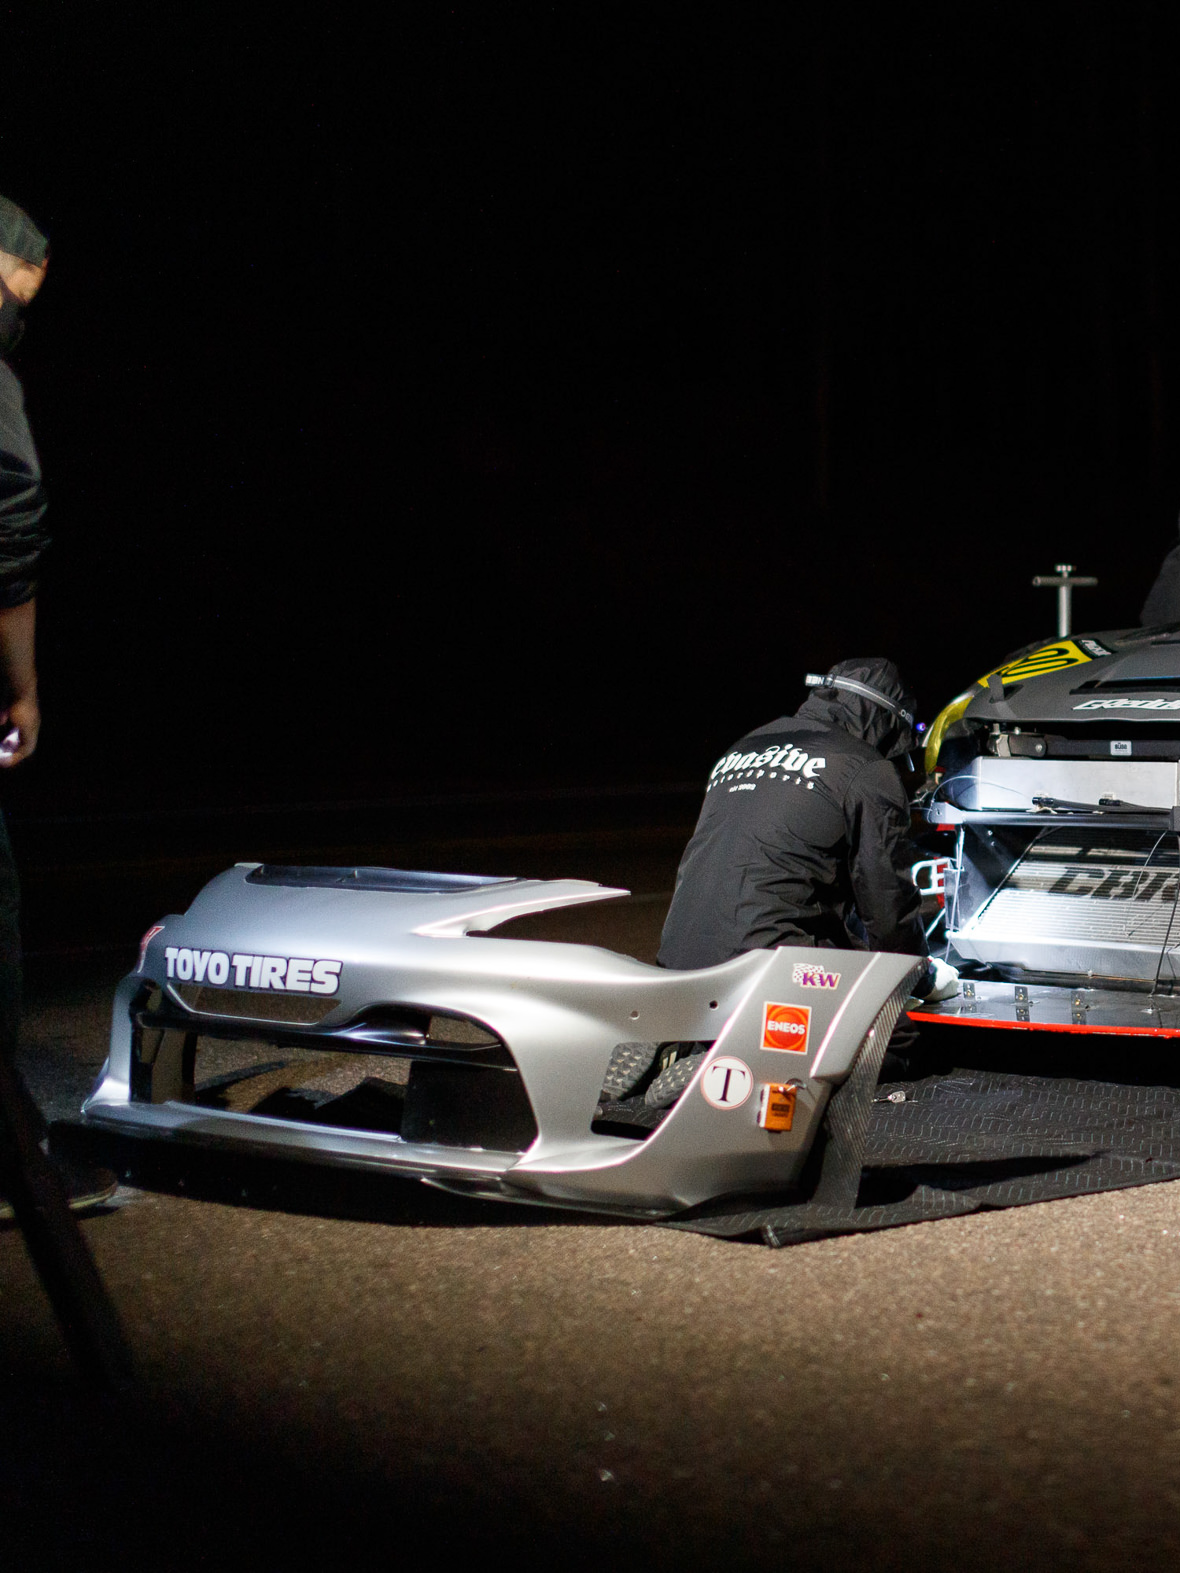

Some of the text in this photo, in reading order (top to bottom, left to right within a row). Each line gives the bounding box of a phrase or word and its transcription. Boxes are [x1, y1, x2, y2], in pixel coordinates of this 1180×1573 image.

[165, 947, 343, 995] TOYO TIRES
[802, 971, 840, 988] KW
[766, 1020, 806, 1035] ENEOS
[710, 1066, 746, 1103] T
